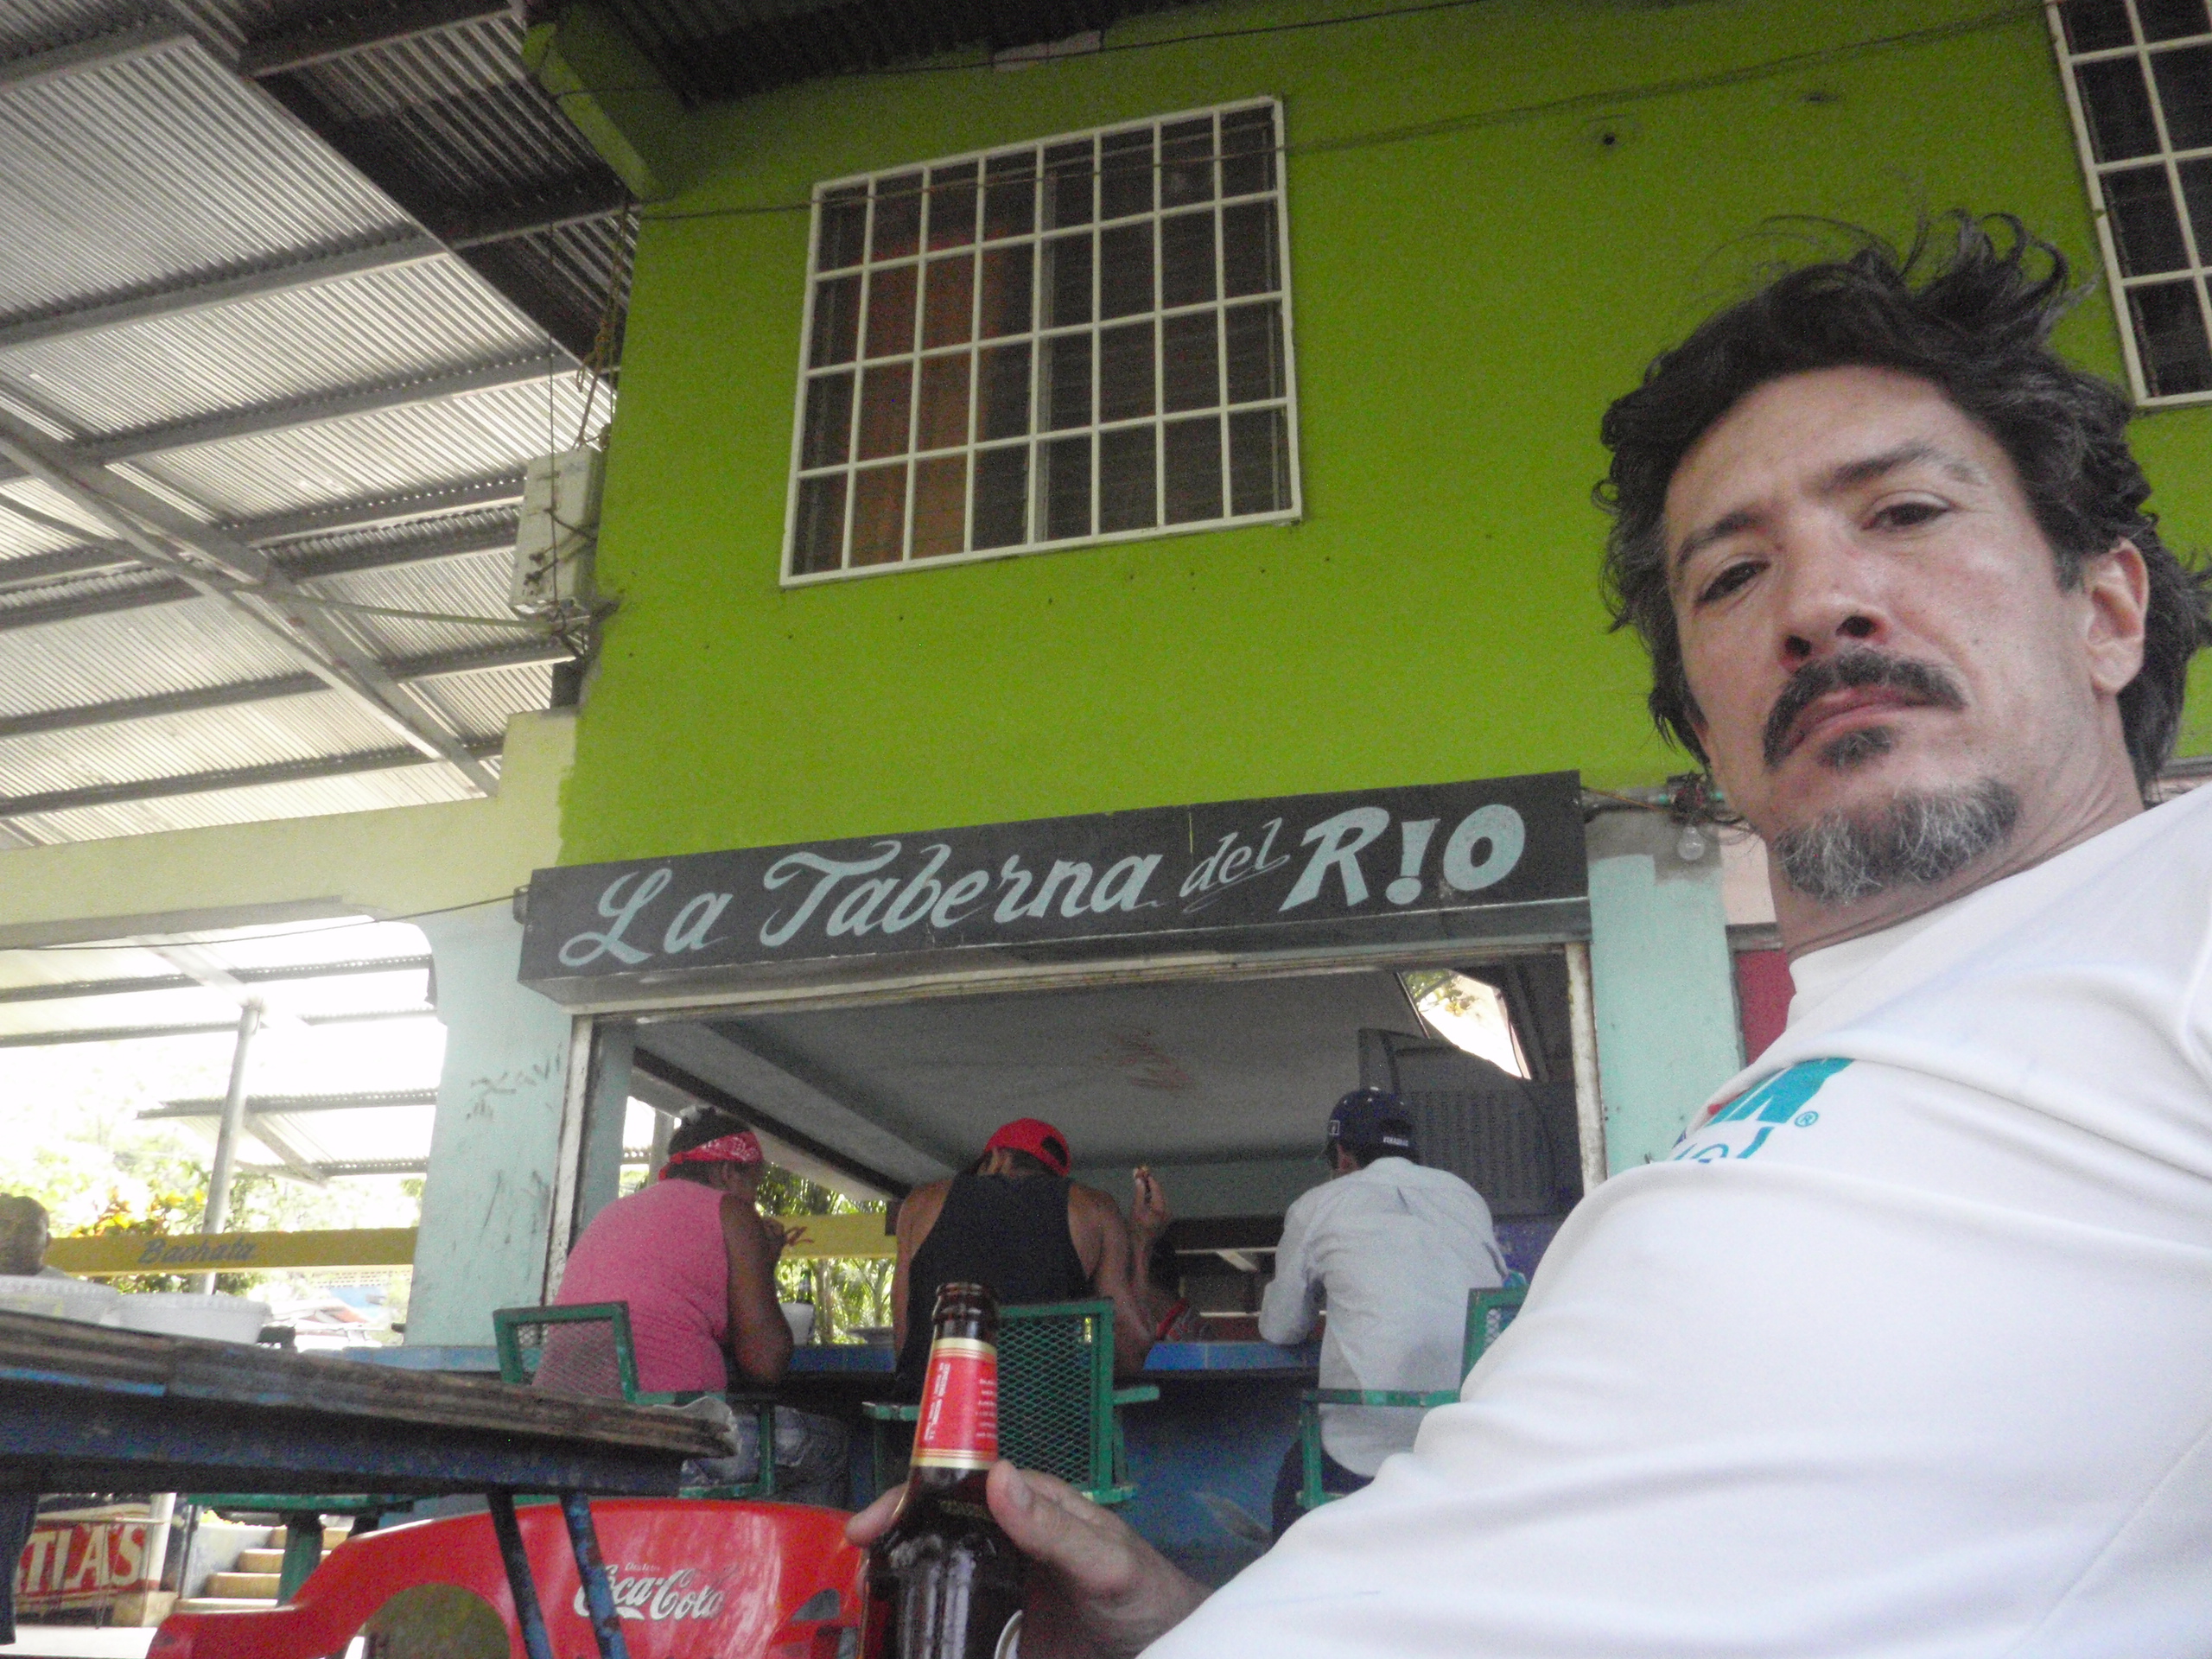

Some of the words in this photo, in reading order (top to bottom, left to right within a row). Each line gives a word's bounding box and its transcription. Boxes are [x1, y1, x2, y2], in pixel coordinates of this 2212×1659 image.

[558, 868, 734, 968] La
[760, 840, 1162, 947] Taberna
[1179, 817, 1291, 899] del
[573, 1562, 726, 1621] Cca-Cola
